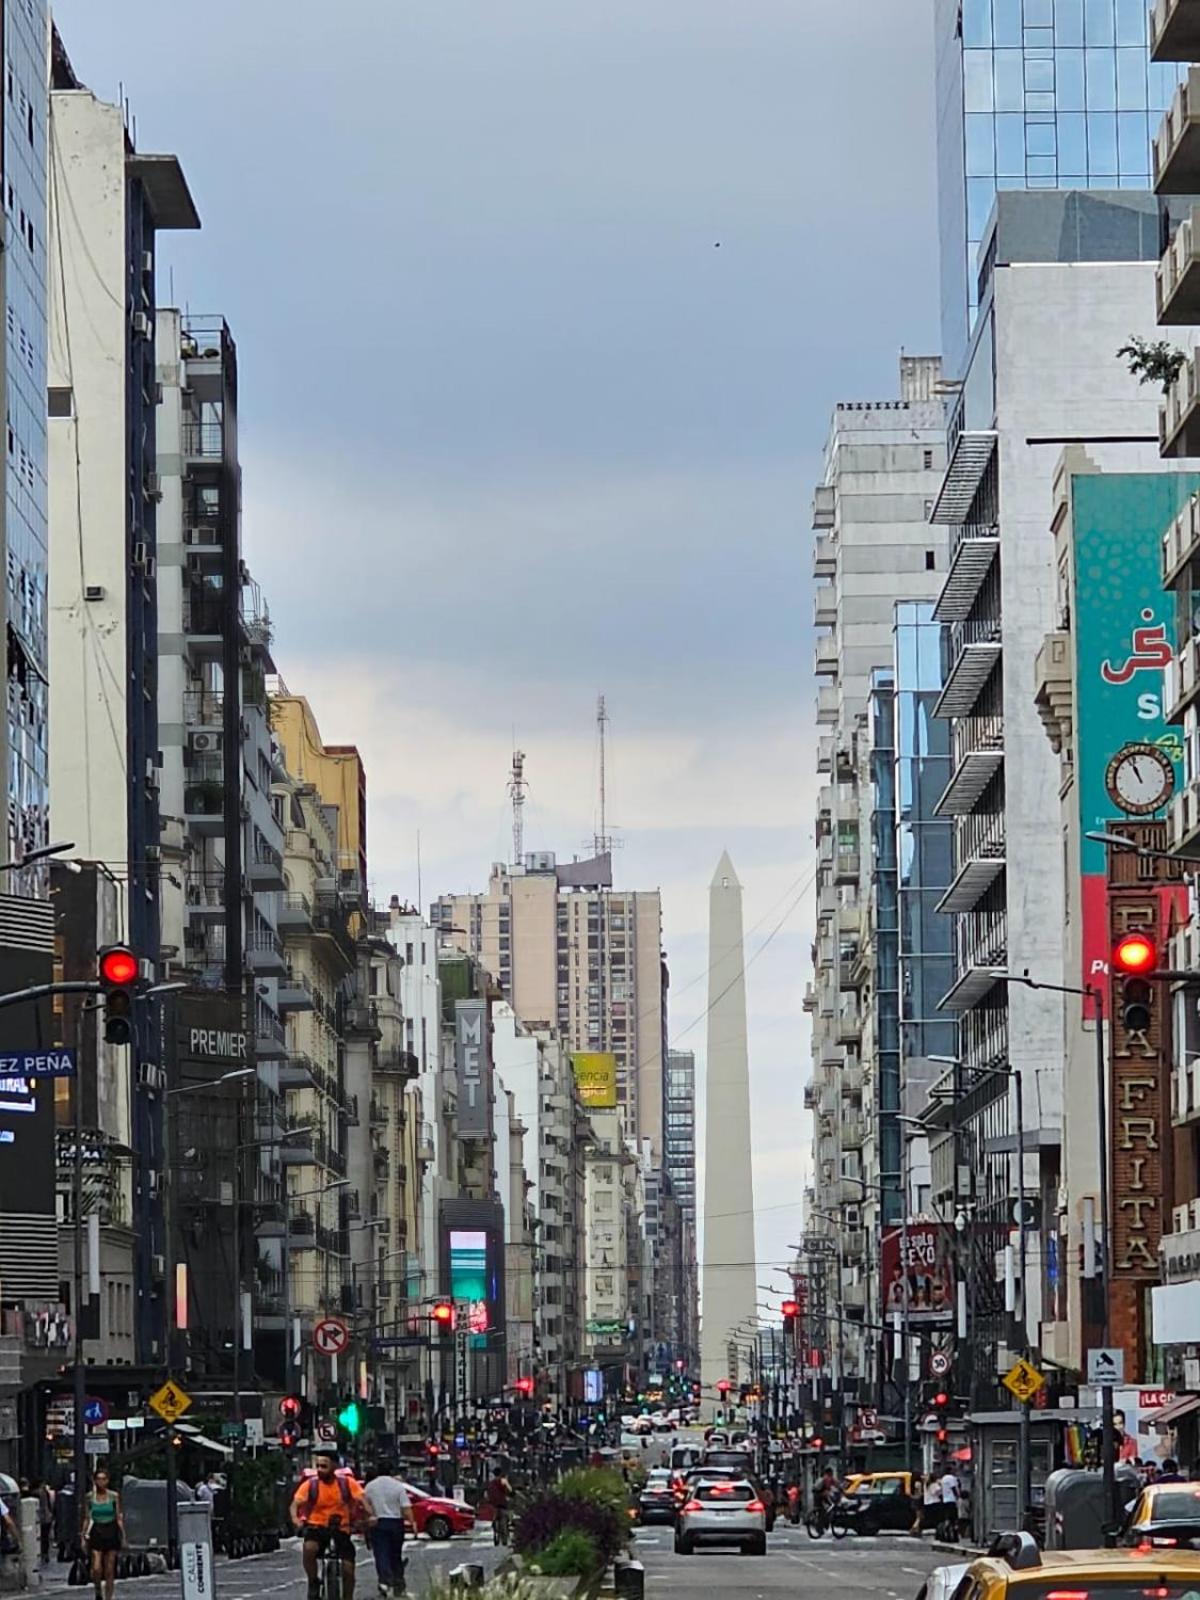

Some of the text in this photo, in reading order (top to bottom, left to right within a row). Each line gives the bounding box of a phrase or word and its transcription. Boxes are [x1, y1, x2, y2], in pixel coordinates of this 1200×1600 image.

[24, 1052, 73, 1071] PEÑA
[190, 1028, 247, 1058] PREMIER
[461, 1013, 481, 1107] MET
[1115, 907, 1158, 1268] PA FRITA
